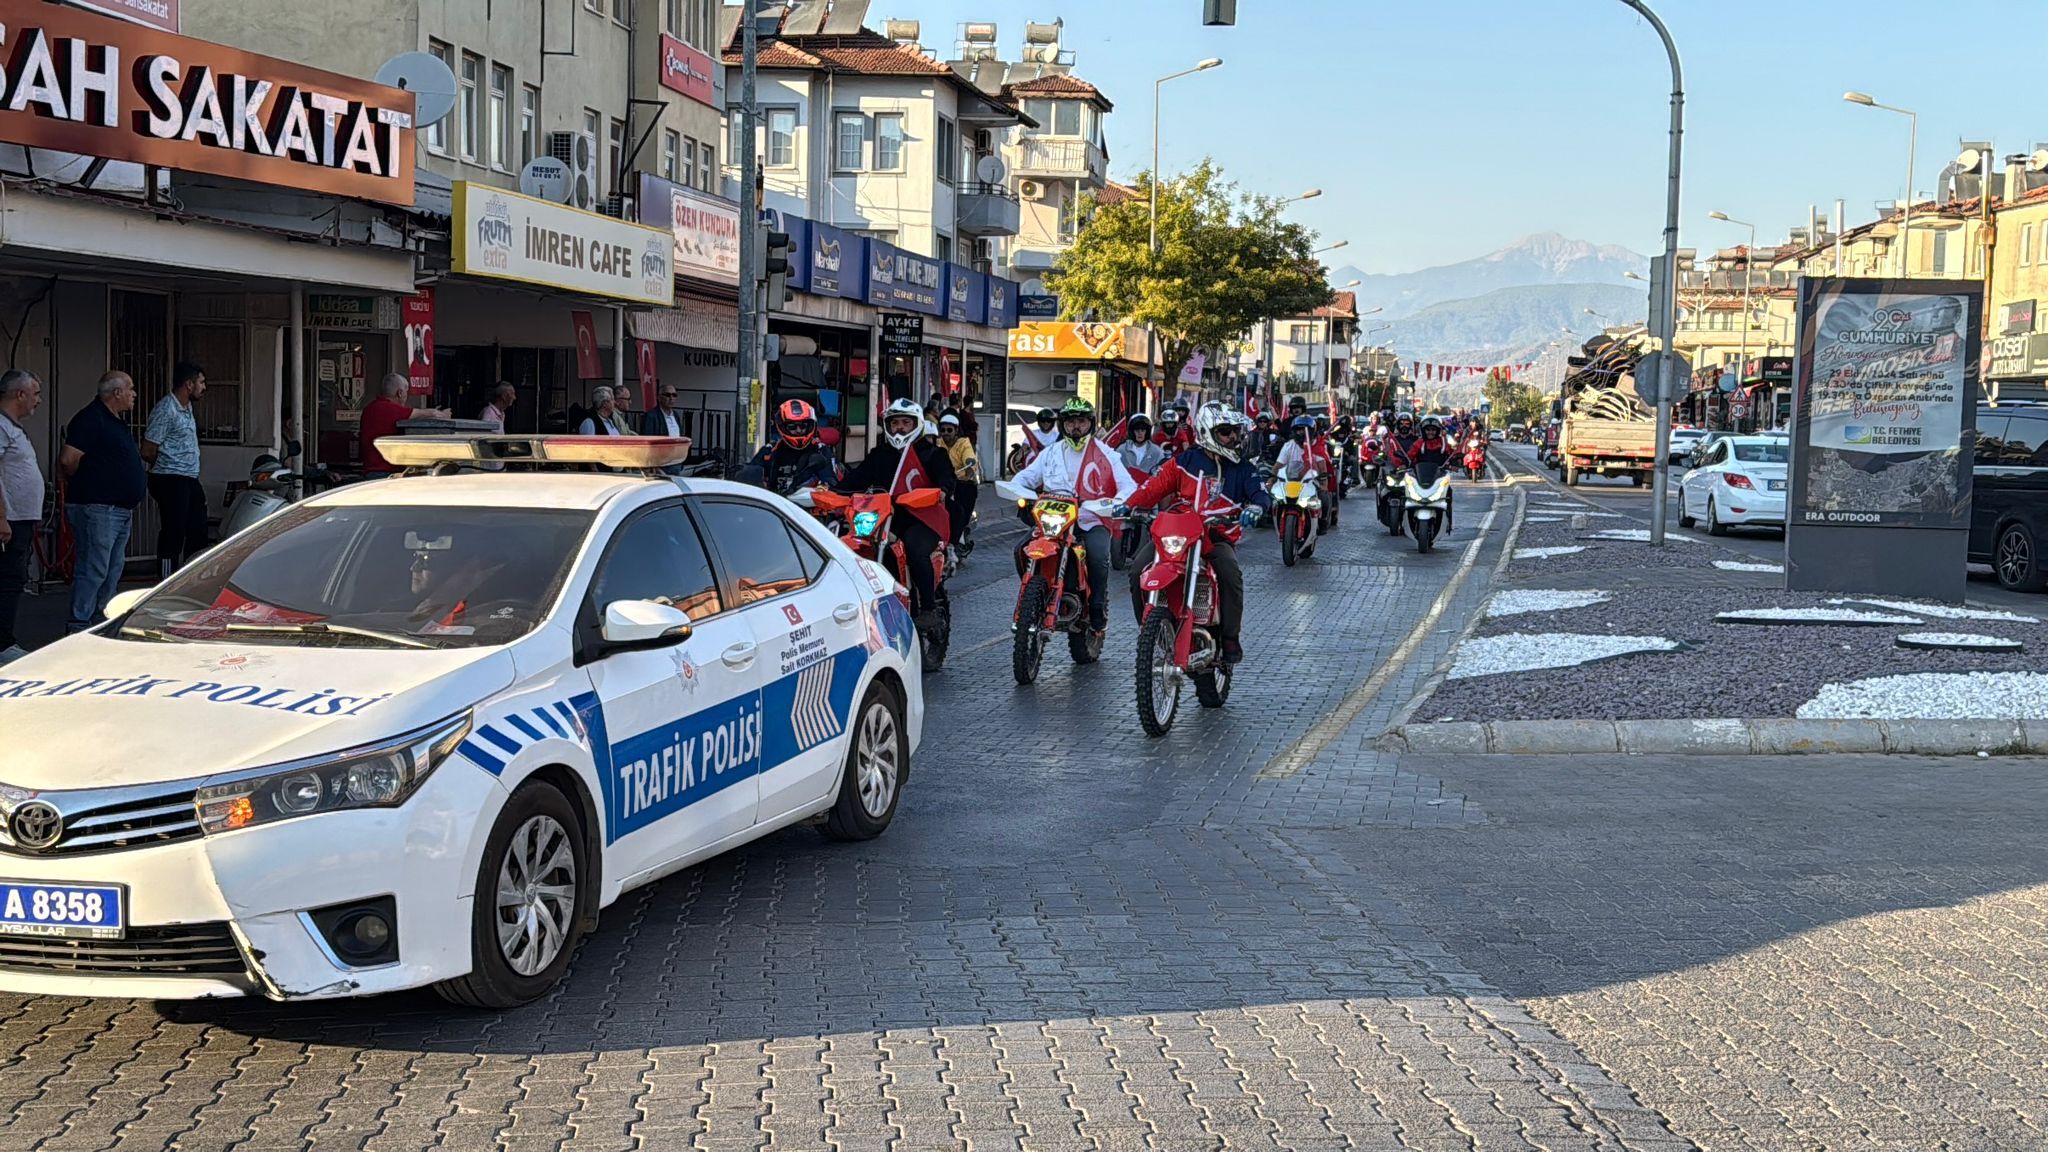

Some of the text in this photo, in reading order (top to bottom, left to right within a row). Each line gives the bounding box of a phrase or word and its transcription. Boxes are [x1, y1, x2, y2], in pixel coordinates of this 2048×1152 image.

[0, 23, 411, 178] AH SAKATAT
[675, 199, 737, 239] ÖZEN KUNDURA
[483, 247, 508, 270] extra
[525, 216, 632, 279] İMREN CAFE
[814, 250, 840, 272] Marshall
[644, 277, 662, 297] extra
[886, 317, 920, 328] AY-KE
[1873, 309, 1904, 332] 29
[1733, 406, 1744, 415] 30
[1044, 501, 1070, 512] 148
[1805, 511, 1881, 522] ERA OUTDOOR
[789, 624, 812, 646] ŞEHİT
[780, 637, 825, 661] Polis Memuru
[796, 647, 828, 670] KORKMAZ
[163, 680, 393, 716] POLİSİ
[620, 699, 762, 819] TRAFİK POLİSİ
[4, 889, 103, 923] A 8358
